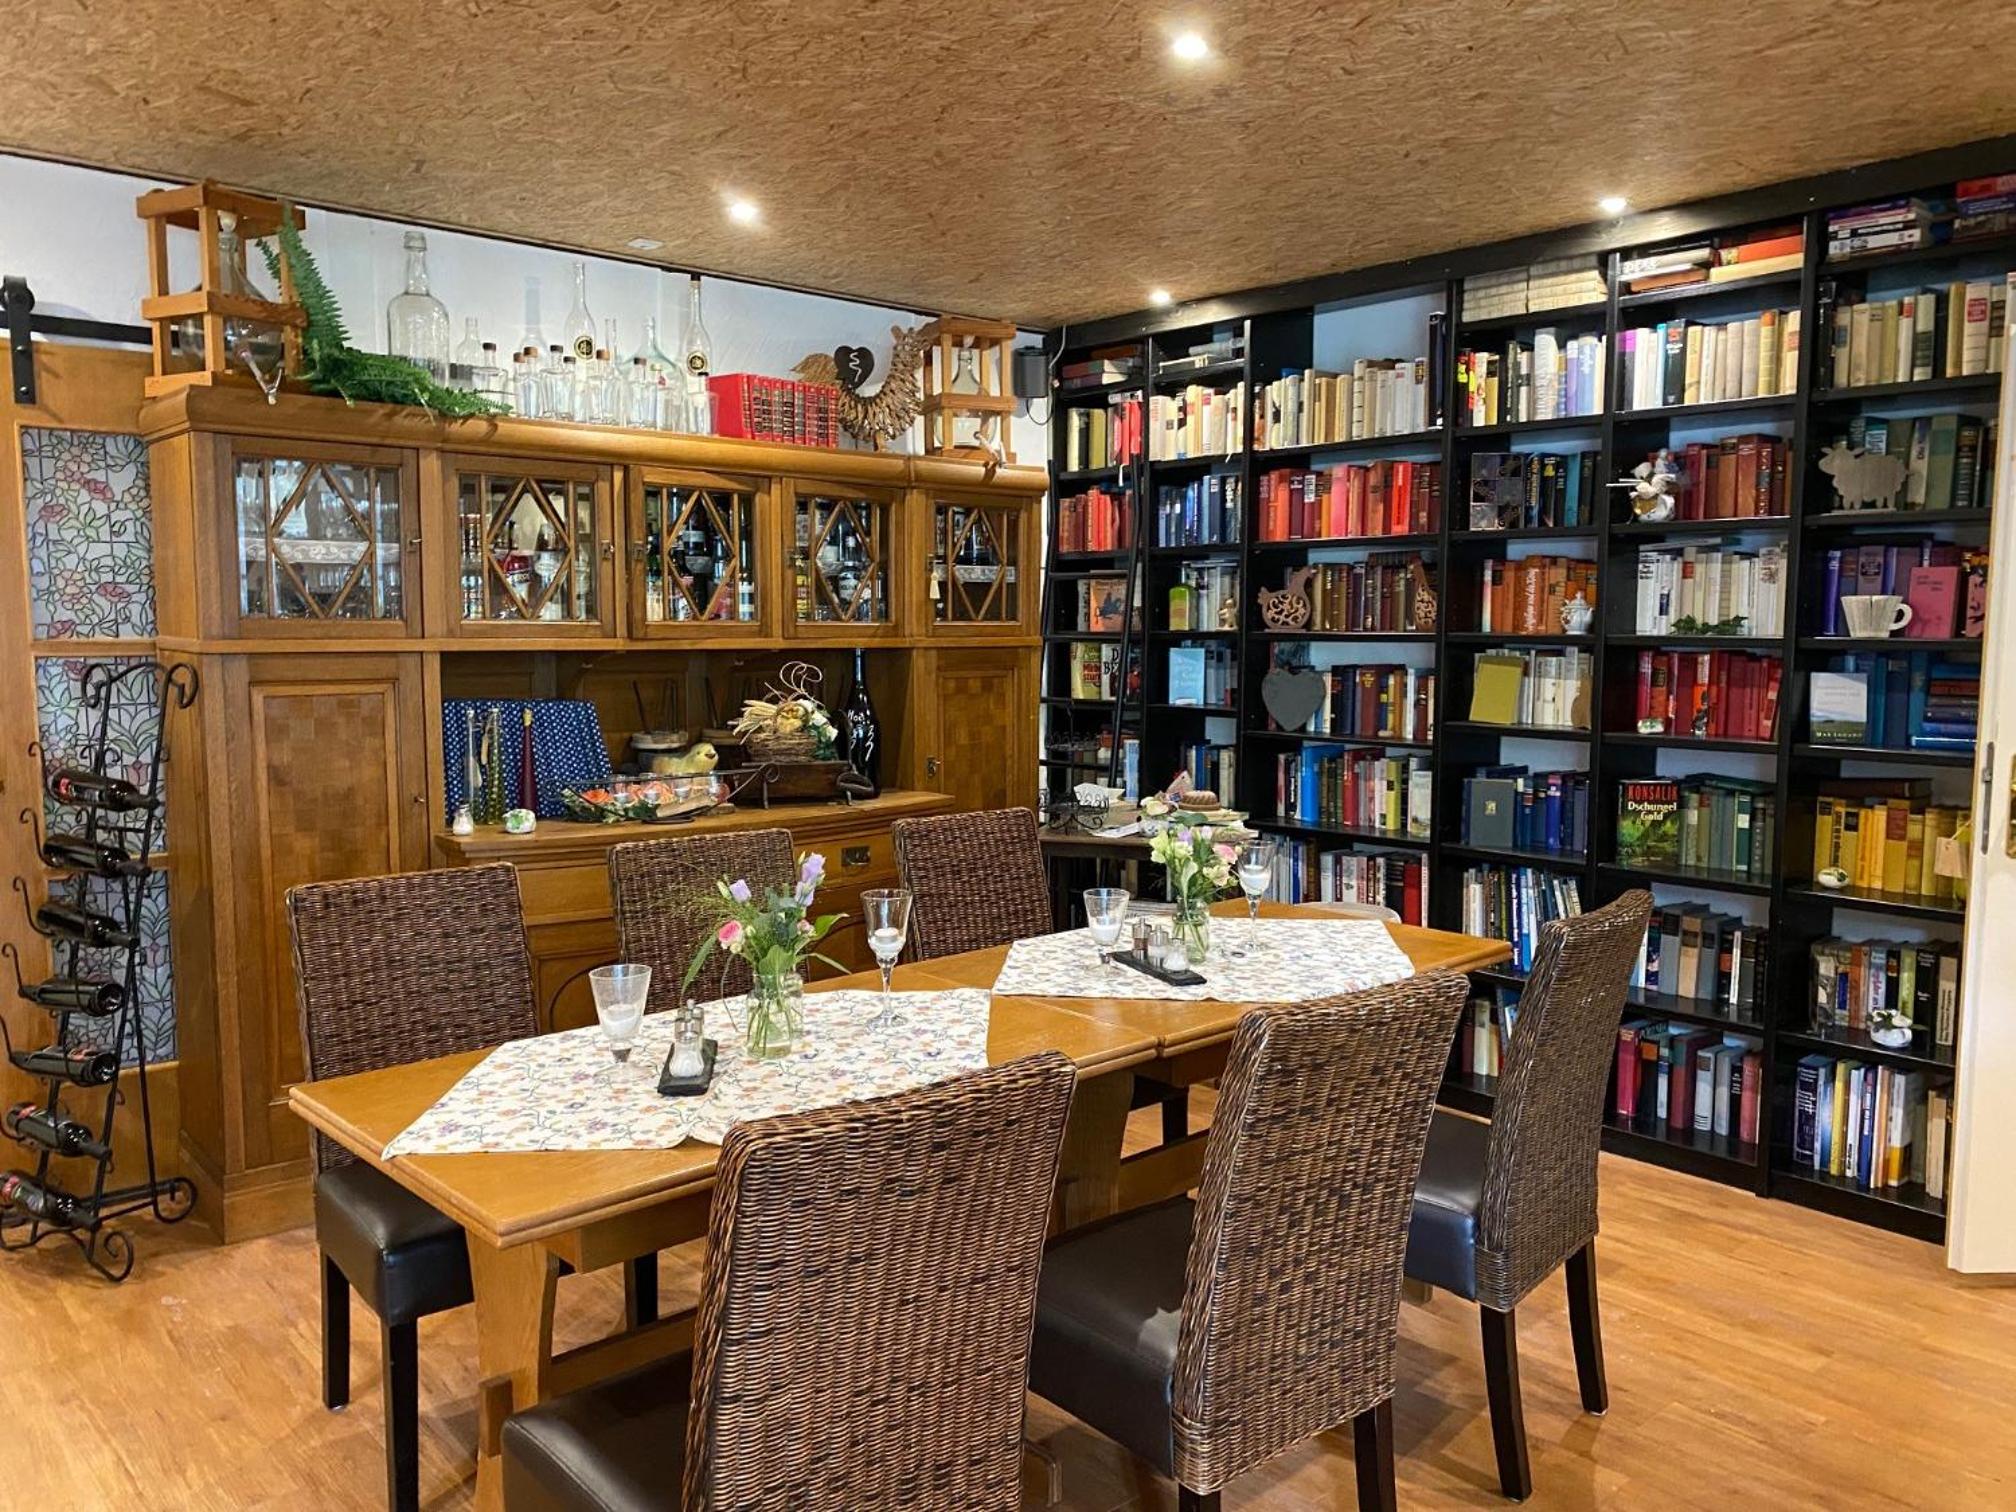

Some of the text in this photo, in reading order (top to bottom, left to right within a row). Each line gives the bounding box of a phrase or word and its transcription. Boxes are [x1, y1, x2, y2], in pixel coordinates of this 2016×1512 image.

[1628, 784, 1678, 801] KONSALIK
[1628, 801, 1677, 813] Dschungel
[1640, 811, 1664, 821] Gold
